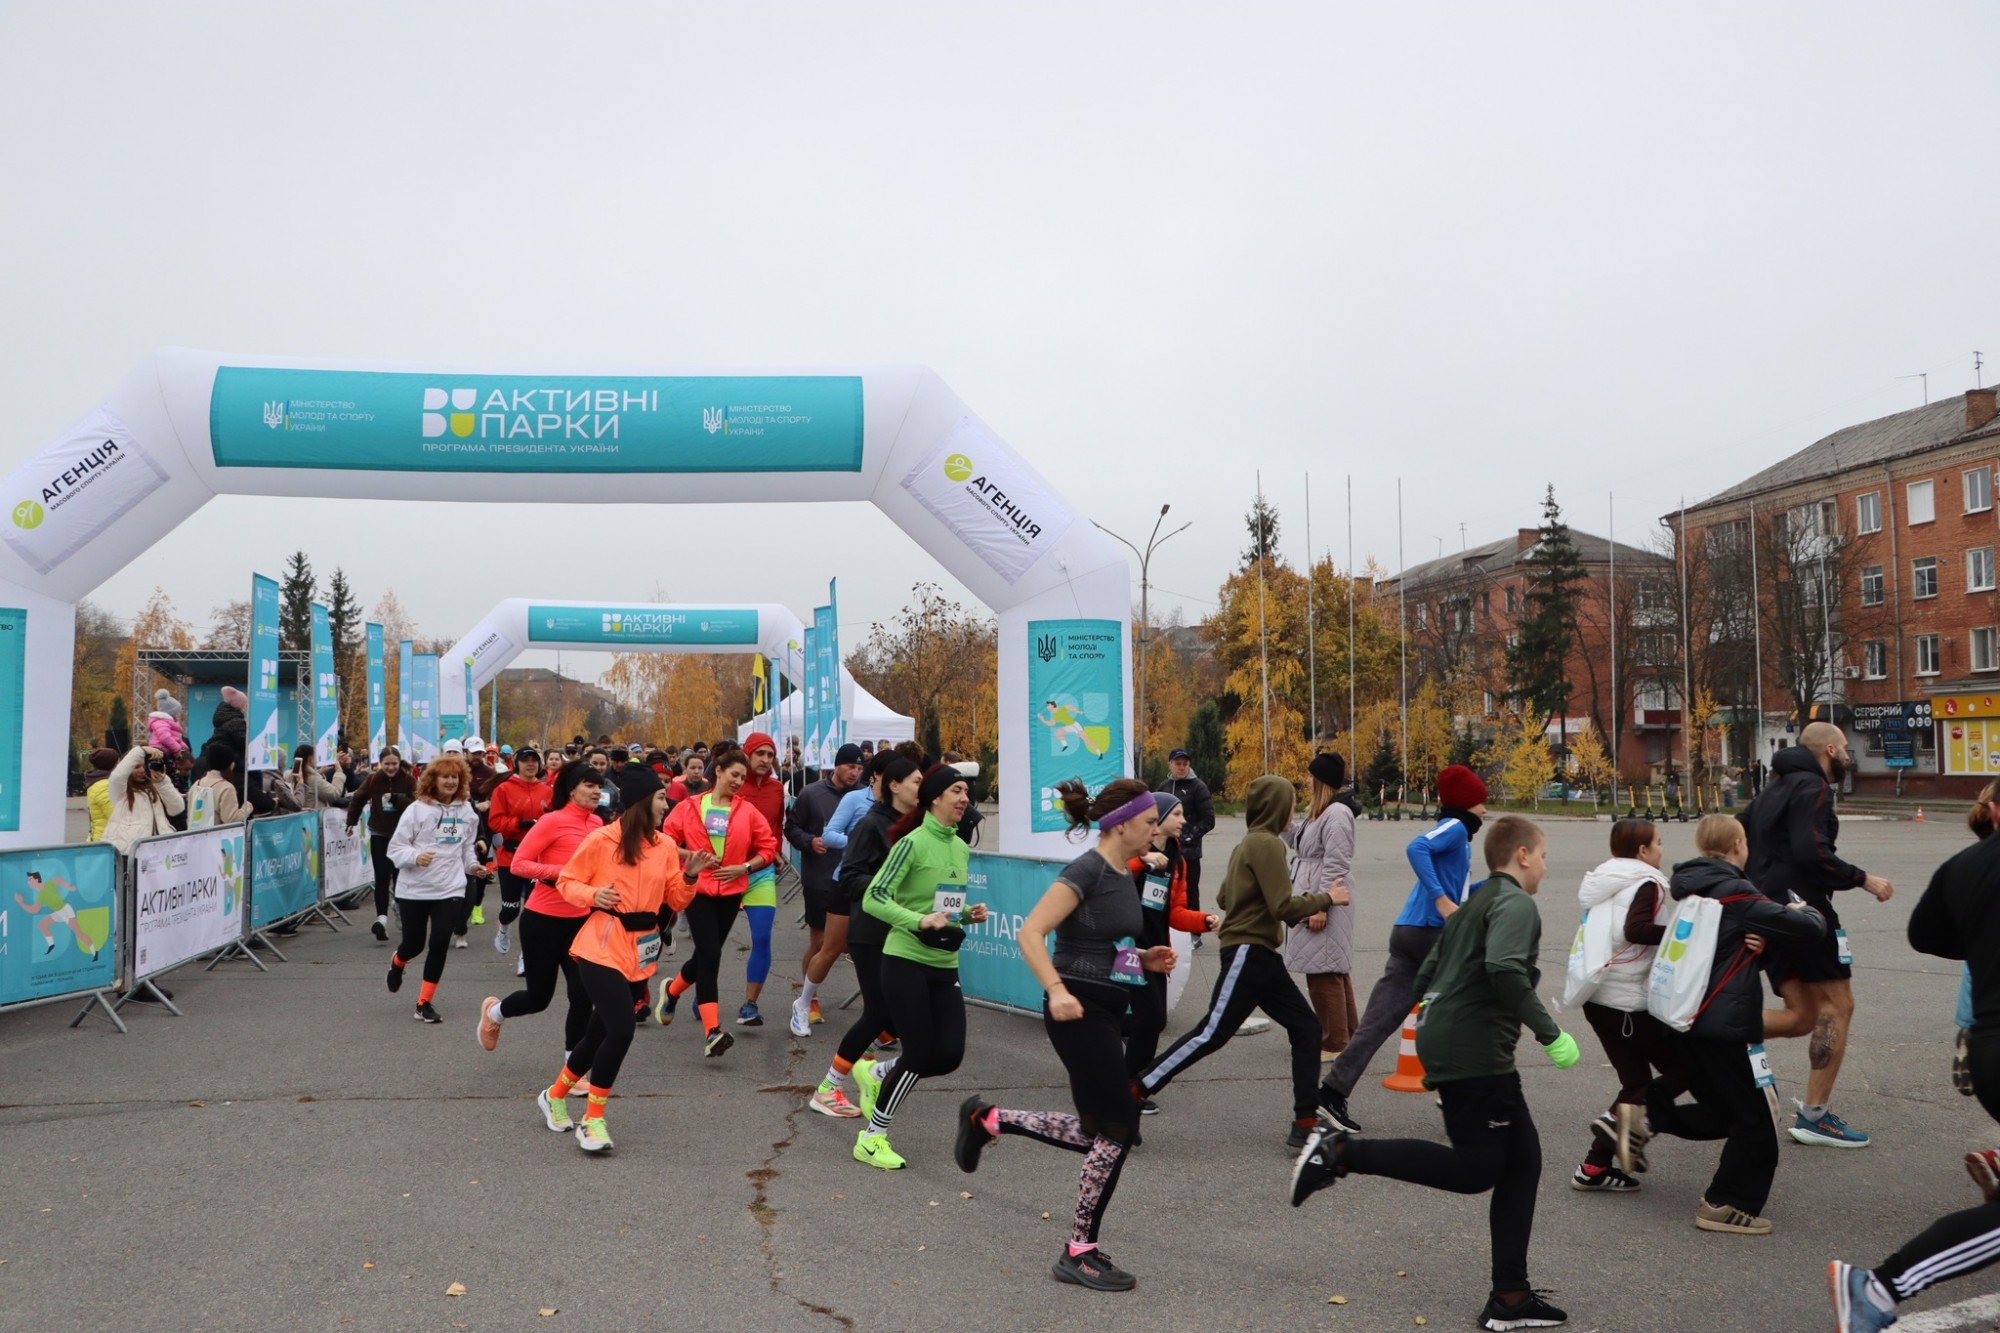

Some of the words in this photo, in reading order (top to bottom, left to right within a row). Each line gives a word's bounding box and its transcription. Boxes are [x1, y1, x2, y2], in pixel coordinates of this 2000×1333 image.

[290, 400, 355, 409] МІНІСТЕРСТВО
[482, 388, 658, 412] АКТИВНІ
[729, 405, 792, 413] МІНІСТЕРСТВО
[290, 411, 325, 421] МОЛОДІ
[326, 412, 338, 421] ТА
[339, 413, 375, 422] СПОРТУ
[729, 416, 764, 425] МОЛОДІ
[764, 416, 776, 424] ТА
[777, 416, 812, 424] СПОРТУ
[290, 422, 326, 432] УКРАЇНИ
[481, 413, 619, 439] ПАРКИ
[729, 427, 764, 436] УКРАЇНИ
[422, 443, 485, 453] ПРОГРАМА
[489, 444, 566, 454] ПРЕЗИДЕНТА
[570, 444, 619, 454] УКРАЇНИ
[42, 439, 119, 503] АГЕНЦІЯ
[50, 486, 81, 511] МАСОВОГО
[80, 471, 102, 490] СПОРТУ
[101, 452, 126, 473] УКРАЇНИ
[972, 476, 1042, 539] АГЕНЦІЯ
[965, 486, 992, 511] МАСОВОГО
[990, 509, 1010, 528] СПОРТУ
[1009, 526, 1031, 546] УКРАЇНИ
[623, 614, 687, 624] АКТИВНІ
[622, 622, 673, 634] ПАРКИ
[1068, 634, 1115, 642] МІНІСТЕРСТВО
[472, 632, 498, 658] АГЕНЦІЯ
[1068, 643, 1098, 651] МОЛОДІ
[1079, 652, 1106, 660] СПОРТУ
[1854, 704, 1902, 718] СЕРВІСНИЙ
[1854, 719, 1881, 730] ЦЕНТР
[967, 873, 987, 884] НЦІЯ
[140, 885, 186, 918] АКТИВНІ
[187, 875, 218, 904] ПАРКИ
[943, 896, 961, 908] 008
[960, 938, 1009, 958] ЗИДЕНТА
